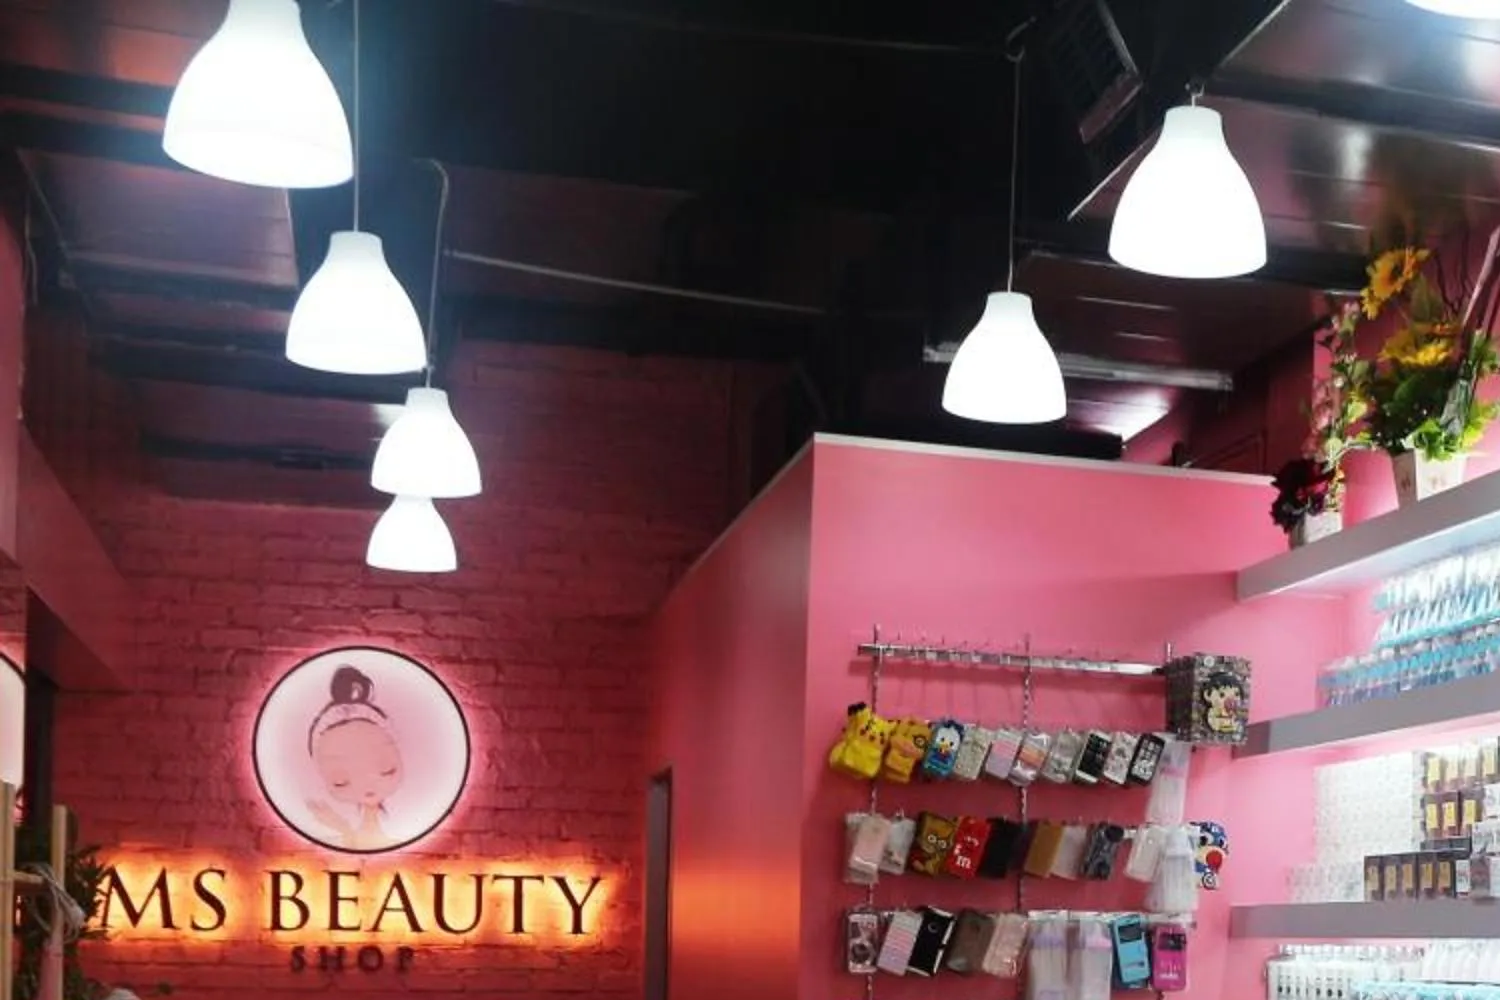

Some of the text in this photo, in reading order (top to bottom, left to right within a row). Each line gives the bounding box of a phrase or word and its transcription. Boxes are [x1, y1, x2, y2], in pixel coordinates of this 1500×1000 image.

[100, 866, 603, 935] MS BEAUTY
[290, 945, 416, 974] SHOP
